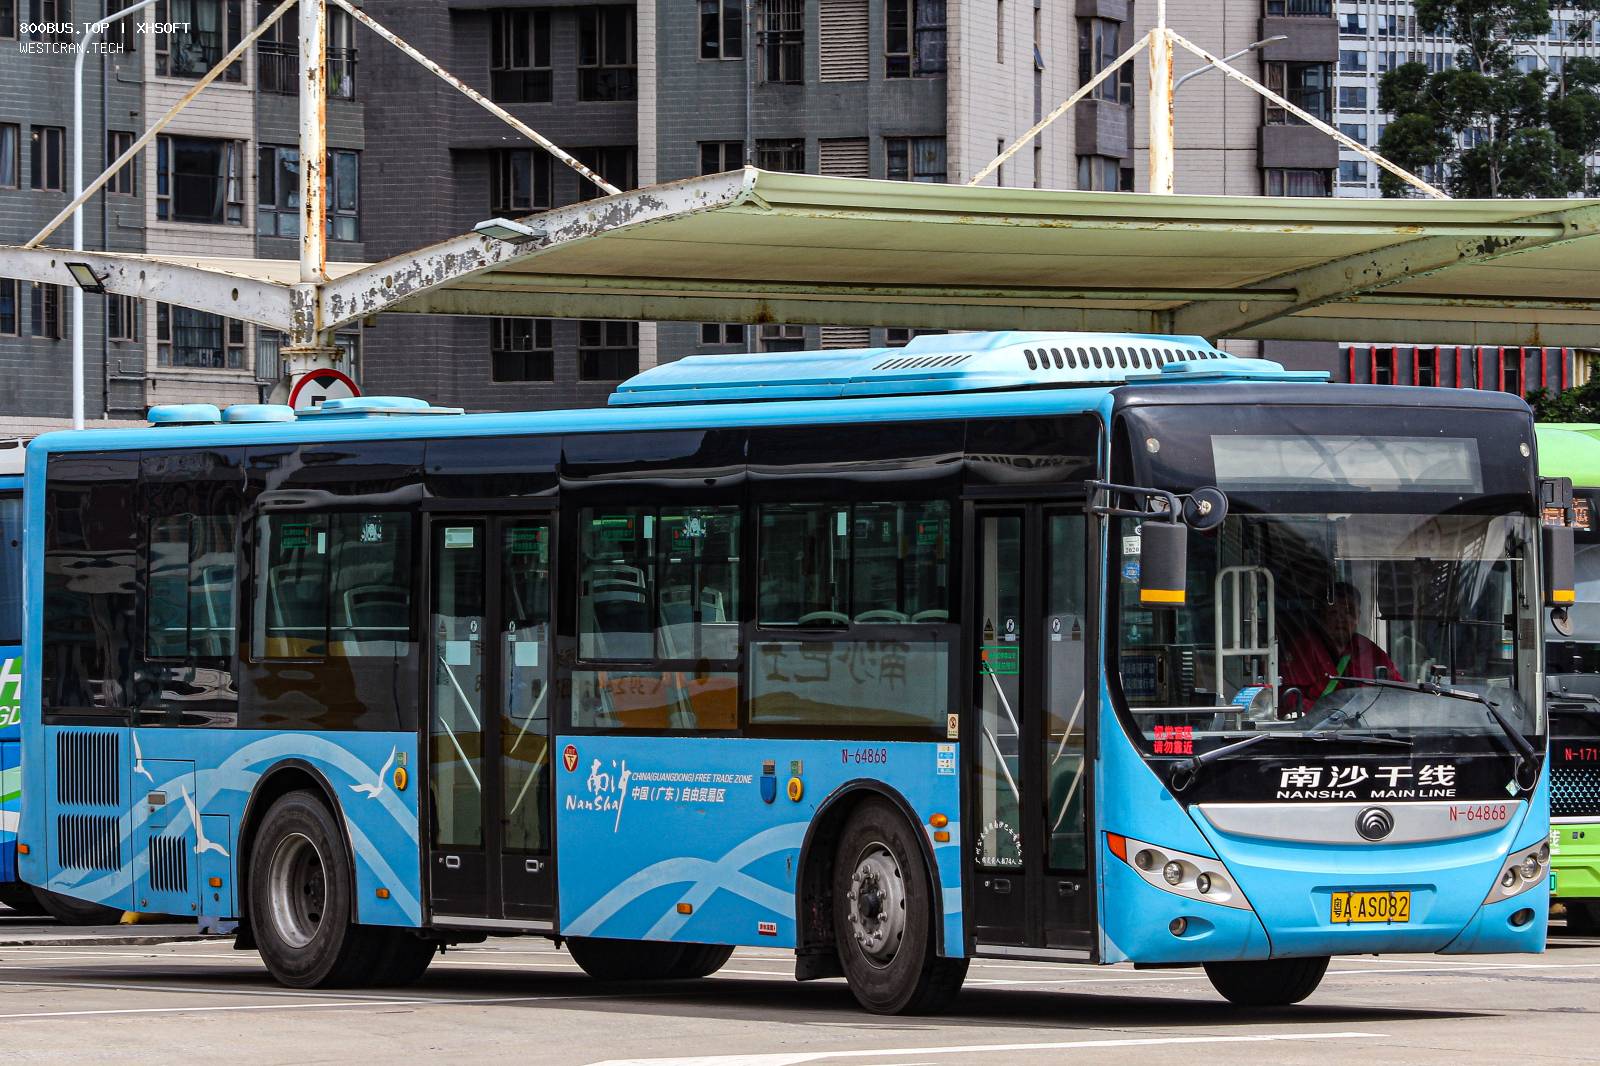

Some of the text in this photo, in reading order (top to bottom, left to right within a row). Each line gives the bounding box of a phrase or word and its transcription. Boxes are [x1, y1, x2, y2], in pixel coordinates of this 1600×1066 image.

[567, 755, 575, 767] 下
[842, 748, 887, 764] N-64868
[1564, 748, 1600, 761] N-171
[695, 773, 712, 783] FREE
[713, 774, 735, 784] TRADE
[735, 774, 752, 784] ZONE
[1280, 765, 1456, 788] 南沙干线
[1276, 789, 1457, 799] NANSHA MAIN LINE
[566, 795, 620, 811] NanSha
[1450, 805, 1506, 821] N-64868
